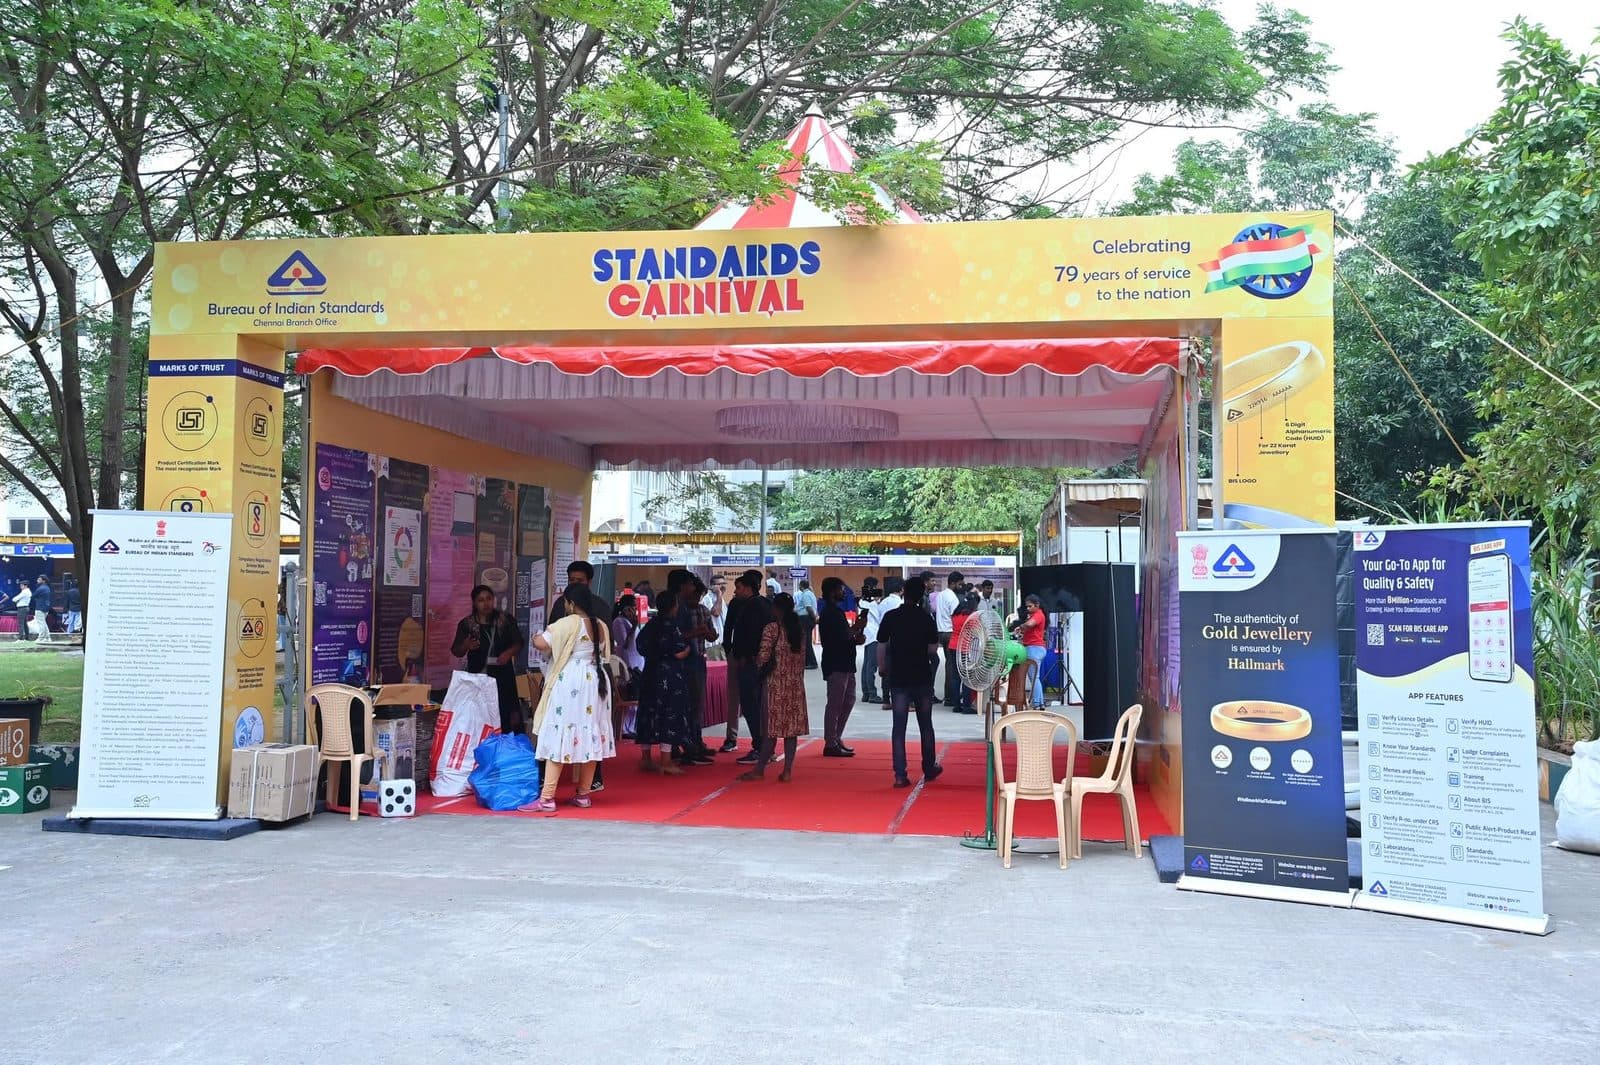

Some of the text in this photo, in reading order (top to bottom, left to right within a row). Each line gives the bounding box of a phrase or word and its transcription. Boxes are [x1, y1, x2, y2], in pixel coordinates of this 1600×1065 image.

[1093, 239, 1190, 254] Celebrating
[593, 241, 821, 285] STANDARDS
[1054, 266, 1190, 283] 79 years of service
[608, 279, 804, 321] CARNIVAL
[1098, 288, 1190, 300] to the nation
[208, 301, 384, 315] Bureau of Indian Standards
[253, 318, 337, 327] Chennai Branch Office
[160, 364, 187, 372] MARKS
[242, 366, 280, 384] MARKS OF TRUST
[1481, 542, 1492, 551] CARE
[1492, 541, 1502, 549] APP
[1362, 558, 1446, 572] Your Go-To App for
[1363, 576, 1434, 591] Quality & Safety
[1214, 613, 1299, 626] The authenticity of
[1202, 625, 1312, 645] Gold Jewellery
[1240, 644, 1270, 653] ensured
[1272, 645, 1282, 654] by
[1228, 658, 1285, 671] Hallmark
[1426, 693, 1464, 701] FEATURES
[1410, 744, 1436, 753] Standards
[1521, 828, 1537, 837] Recall
[1466, 847, 1493, 855] Standards
